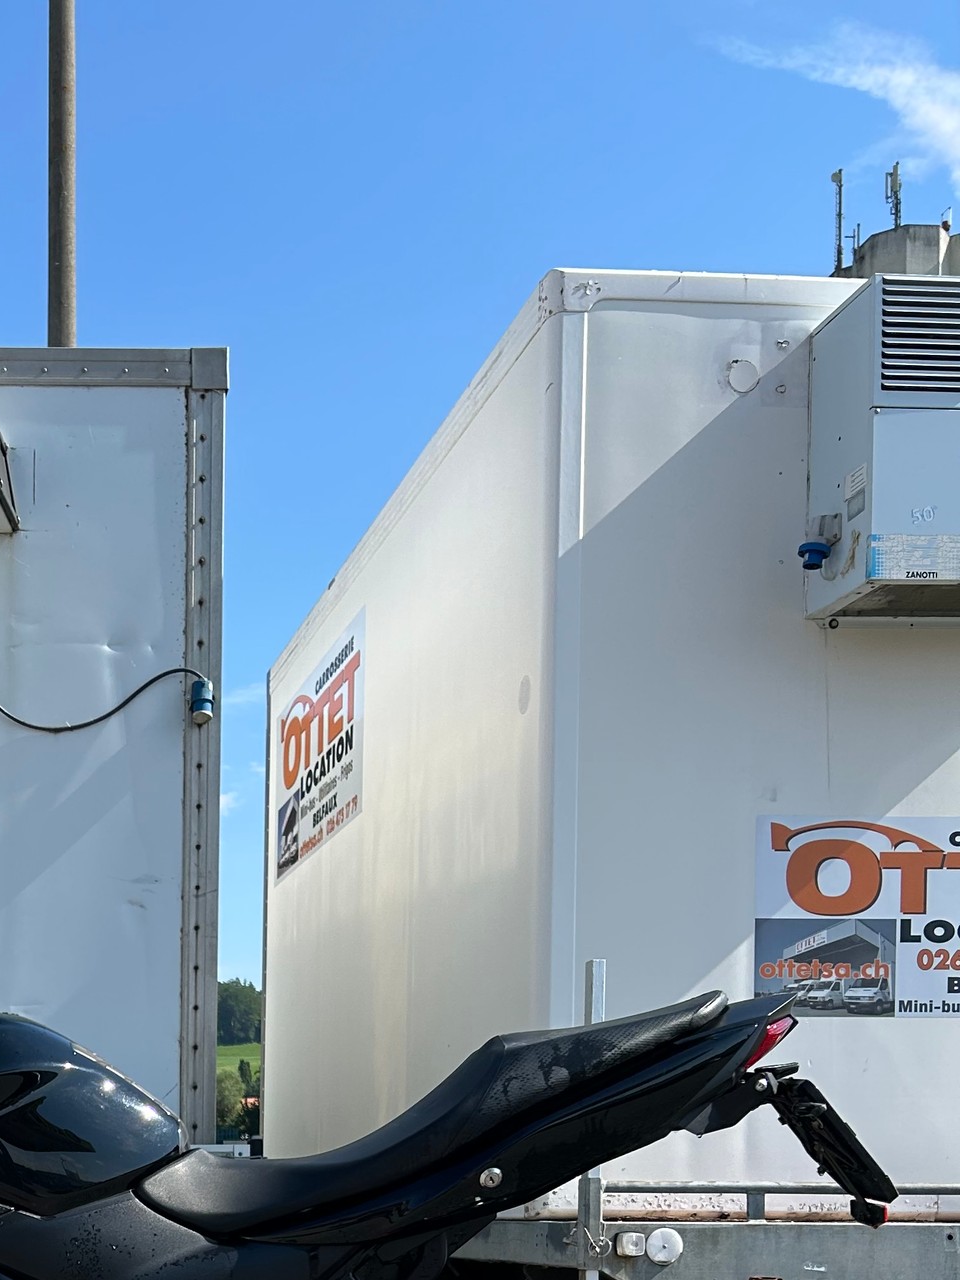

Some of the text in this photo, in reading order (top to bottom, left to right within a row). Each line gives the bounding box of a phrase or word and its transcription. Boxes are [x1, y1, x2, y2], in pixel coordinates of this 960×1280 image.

[905, 571, 938, 579] ZANOTTI
[283, 649, 361, 790] OTTET
[300, 723, 354, 801] LOCATION
[312, 791, 338, 829] BELFAUX
[786, 838, 960, 916] OT
[900, 918, 960, 944] LO
[759, 957, 890, 980] ottetsa.ch
